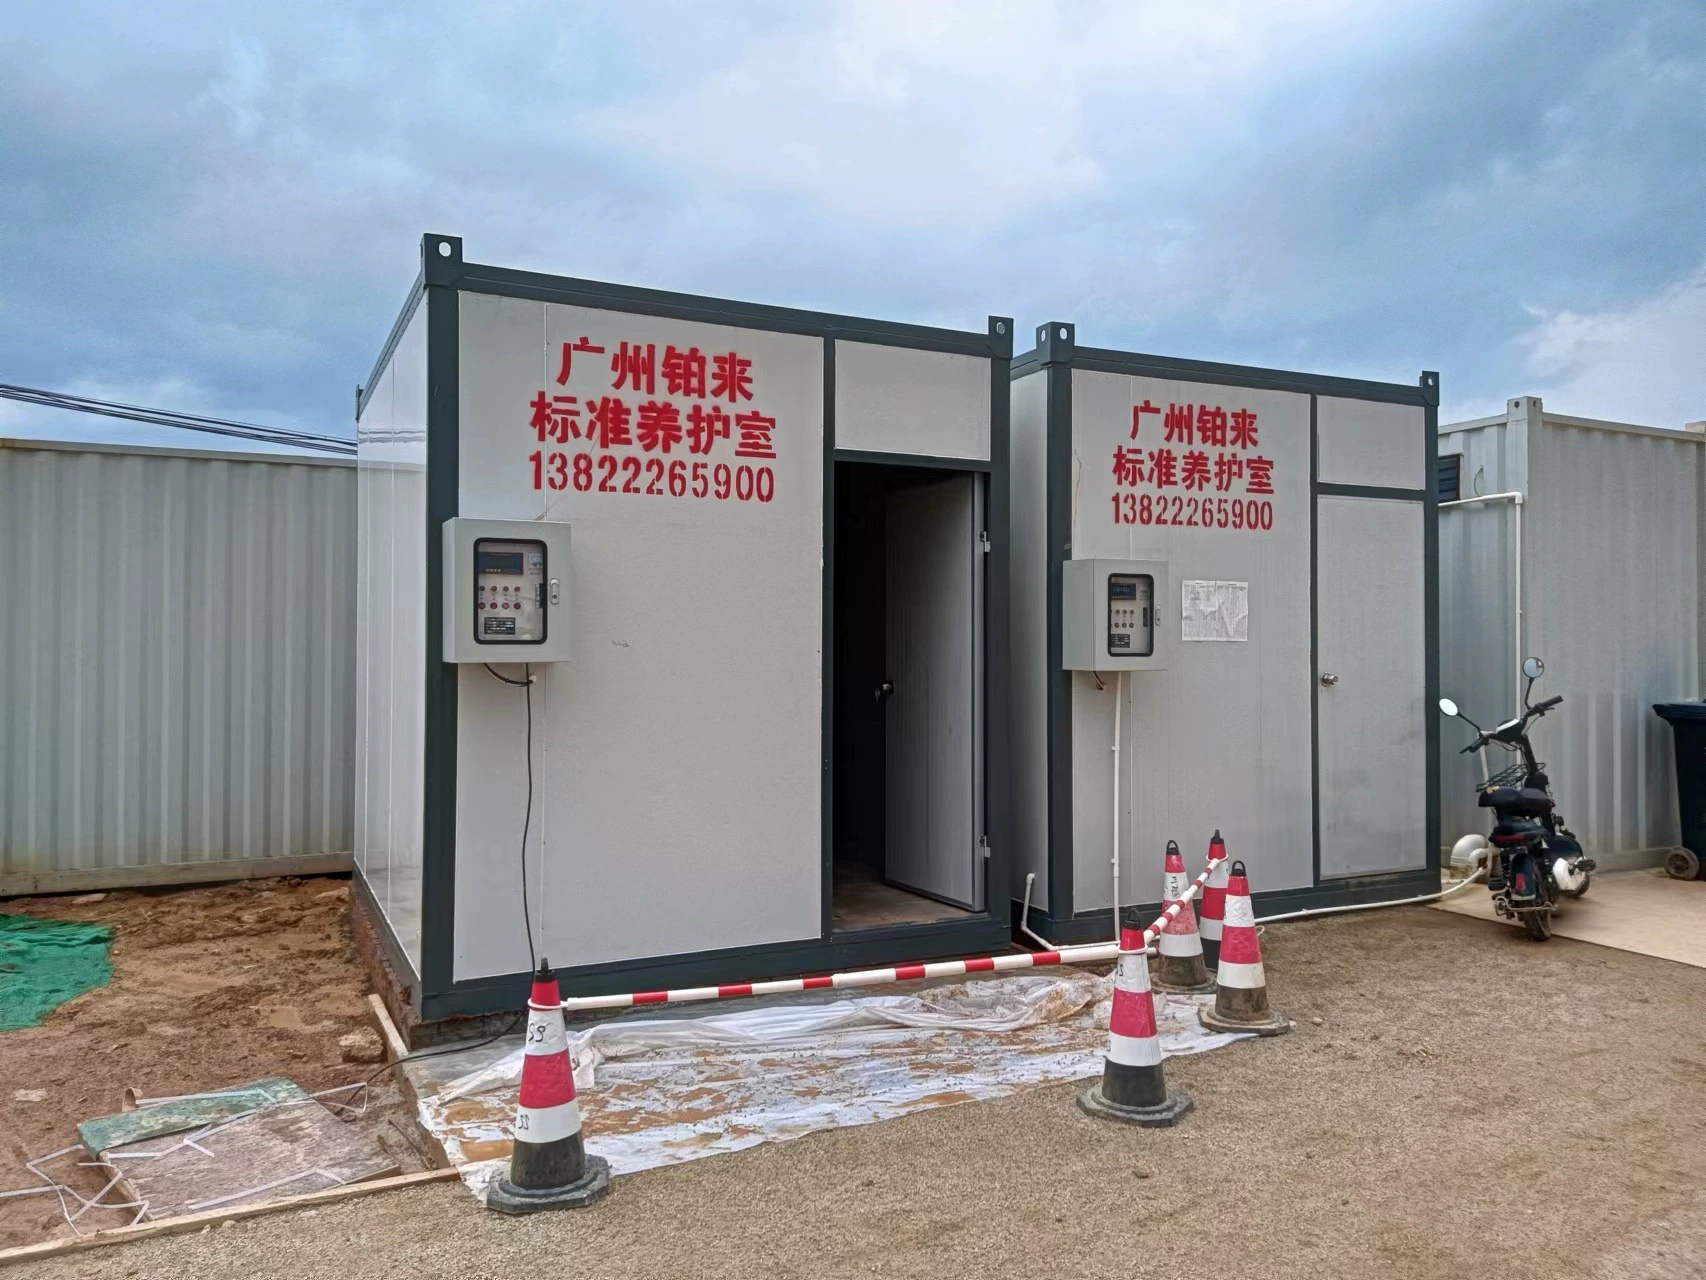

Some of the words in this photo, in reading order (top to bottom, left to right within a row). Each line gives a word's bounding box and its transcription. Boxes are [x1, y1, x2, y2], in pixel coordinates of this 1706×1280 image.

[556, 336, 754, 403] 广州铂来
[529, 391, 777, 459] 标准养护室
[1130, 400, 1259, 450] 广州铂来
[529, 450, 775, 503] 13822265900
[1112, 445, 1275, 494] 标准养护室
[1111, 492, 1273, 531] 13822265900
